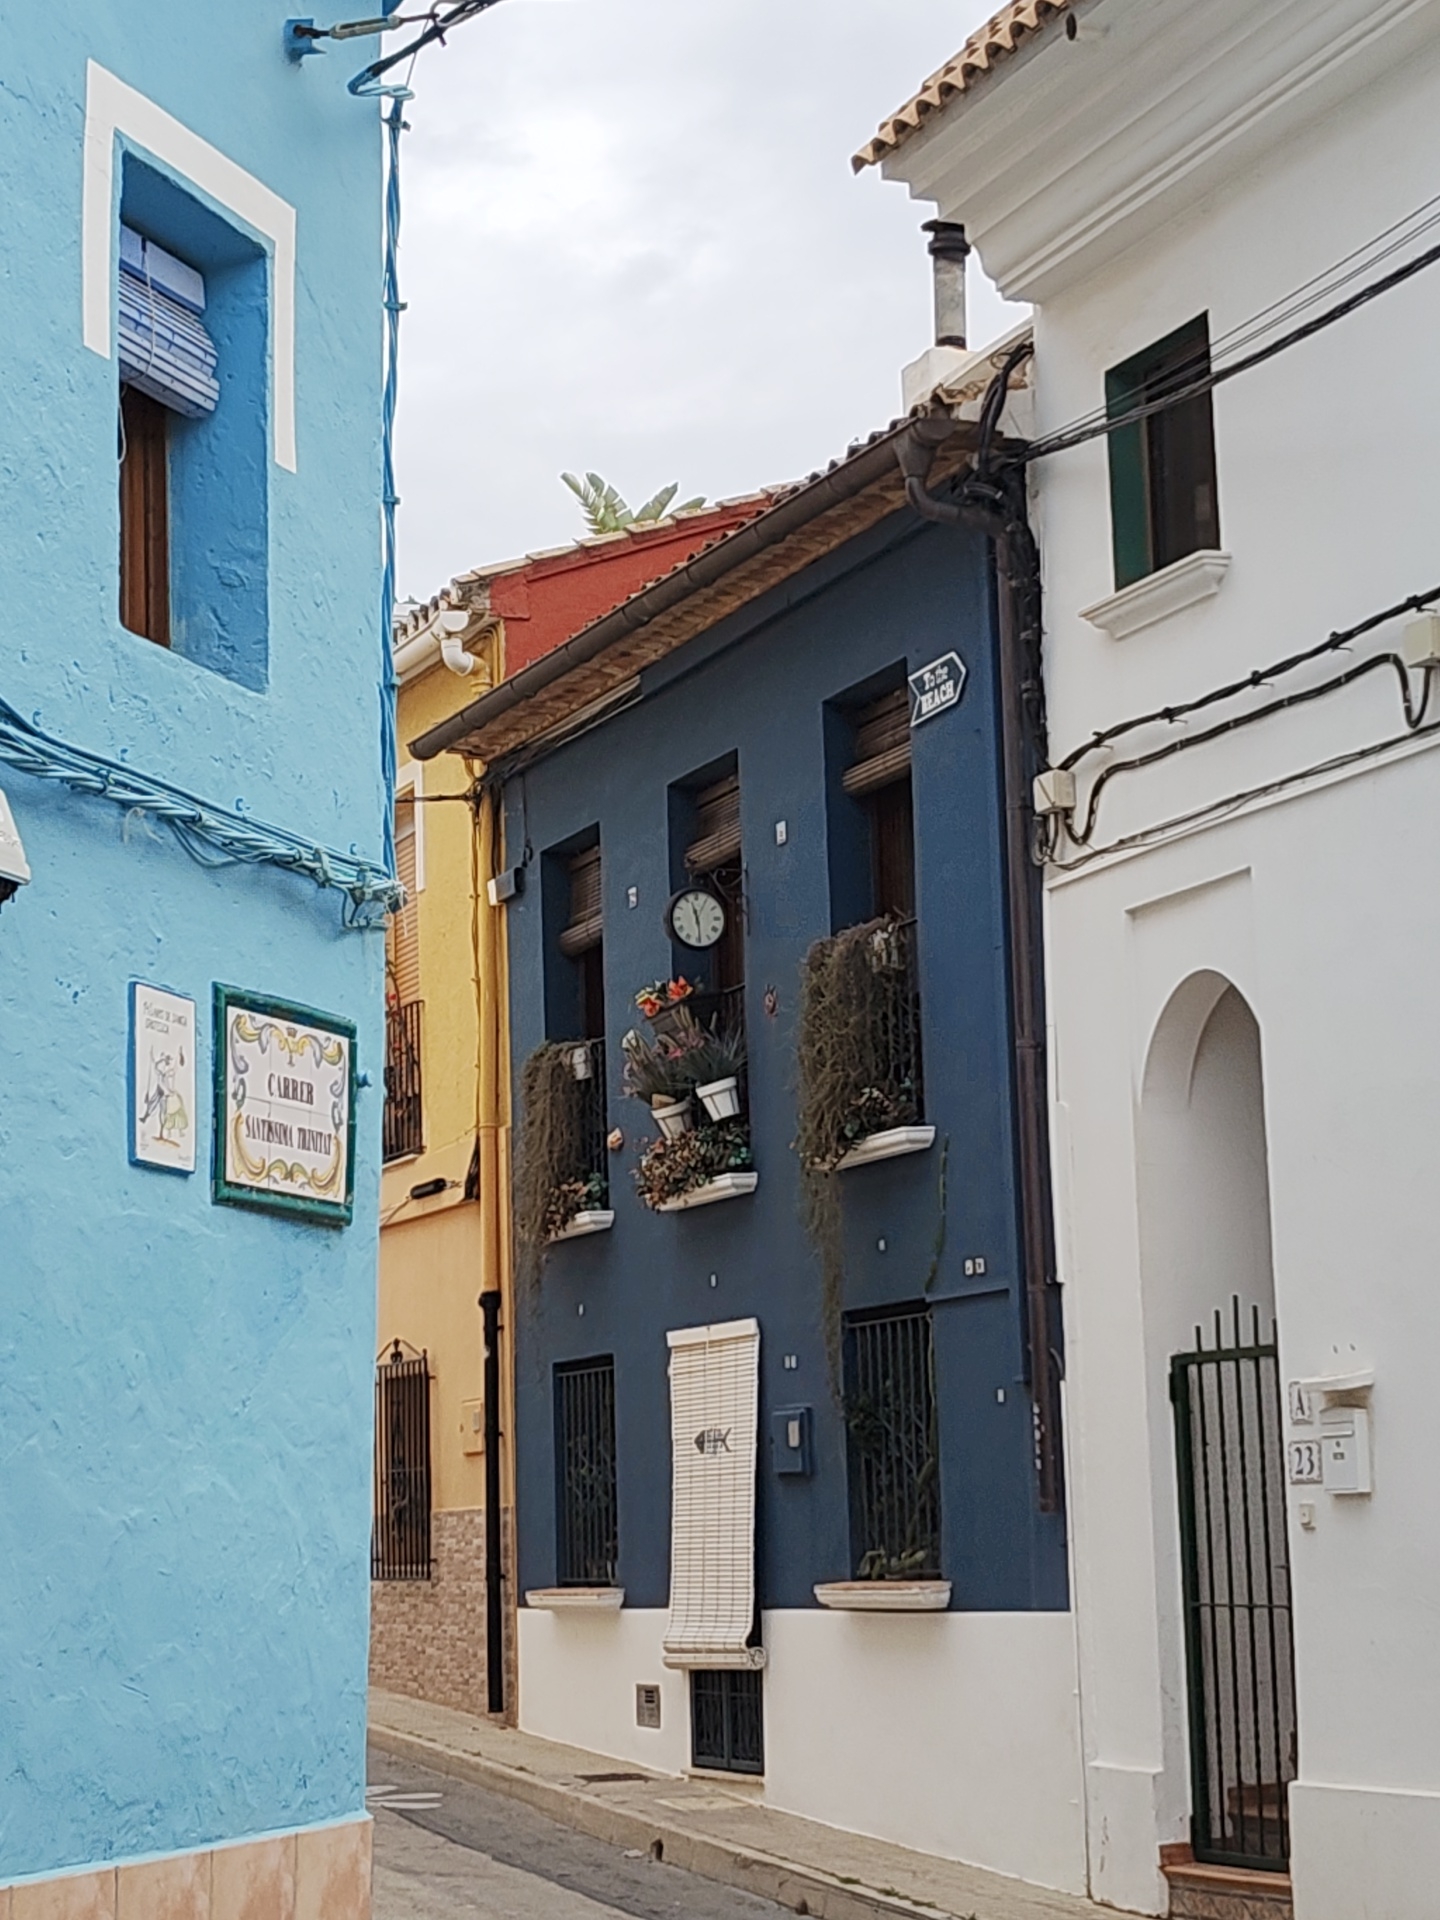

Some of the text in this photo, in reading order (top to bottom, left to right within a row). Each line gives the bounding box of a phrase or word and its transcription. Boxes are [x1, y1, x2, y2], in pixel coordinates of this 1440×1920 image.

[923, 664, 949, 691] To the
[920, 680, 955, 714] BEACH
[267, 1072, 314, 1106] CARRER
[1294, 1446, 1315, 1475] 23
